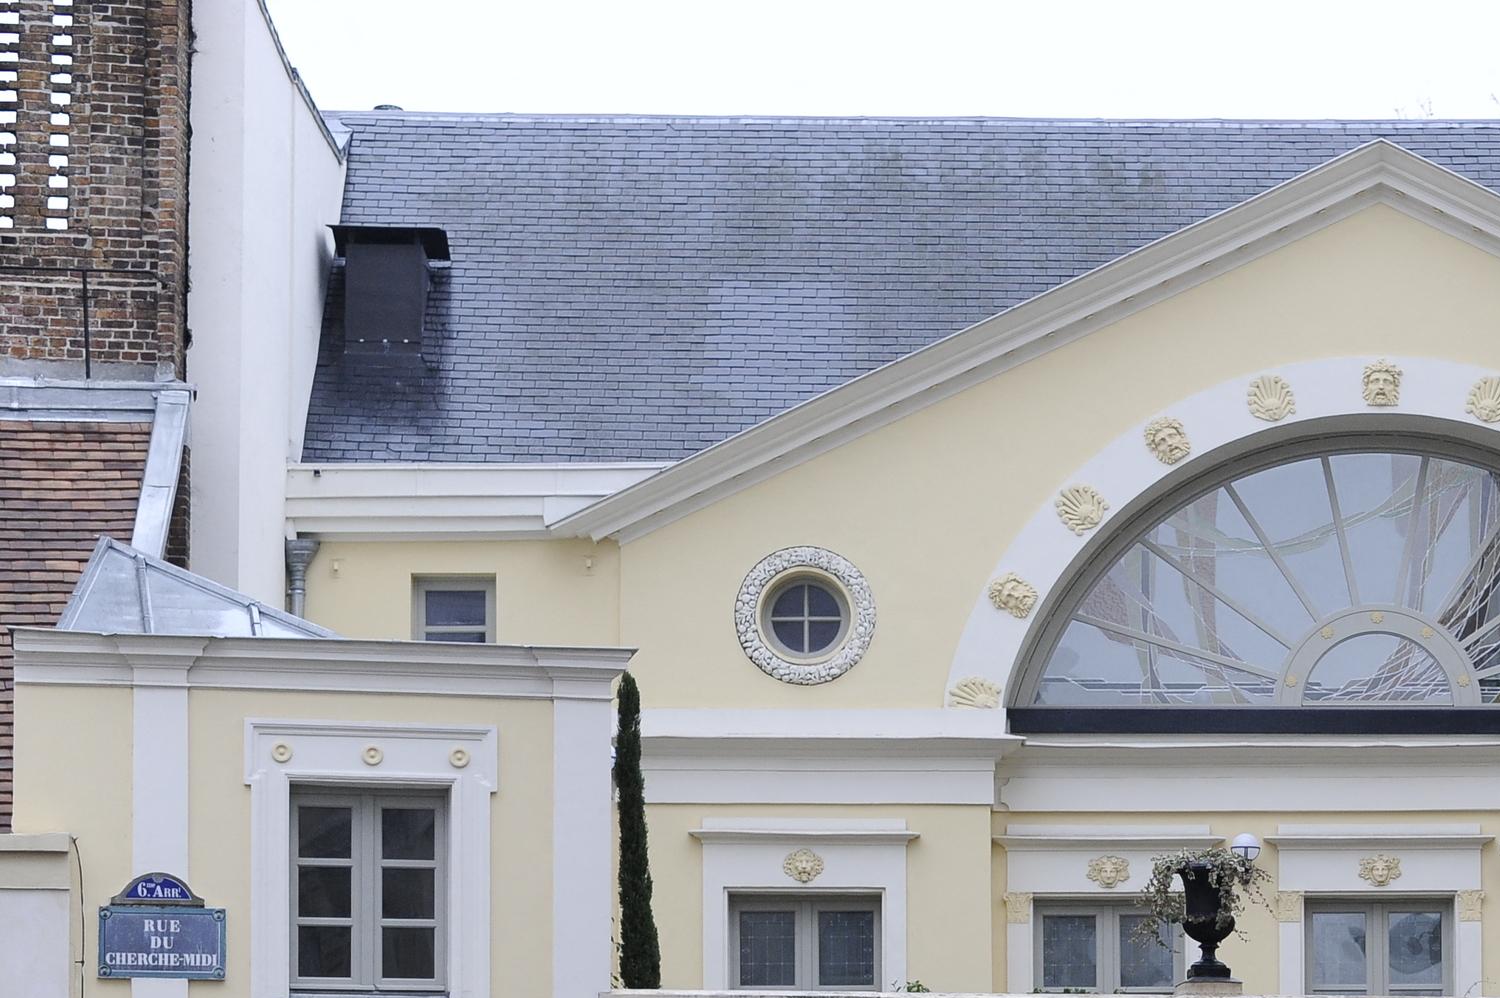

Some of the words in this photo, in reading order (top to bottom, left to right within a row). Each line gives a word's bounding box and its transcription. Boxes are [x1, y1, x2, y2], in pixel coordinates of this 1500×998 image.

[143, 919, 181, 933] RUE
[150, 936, 174, 949] DU
[105, 952, 218, 967] CHERCHE-MIDI
